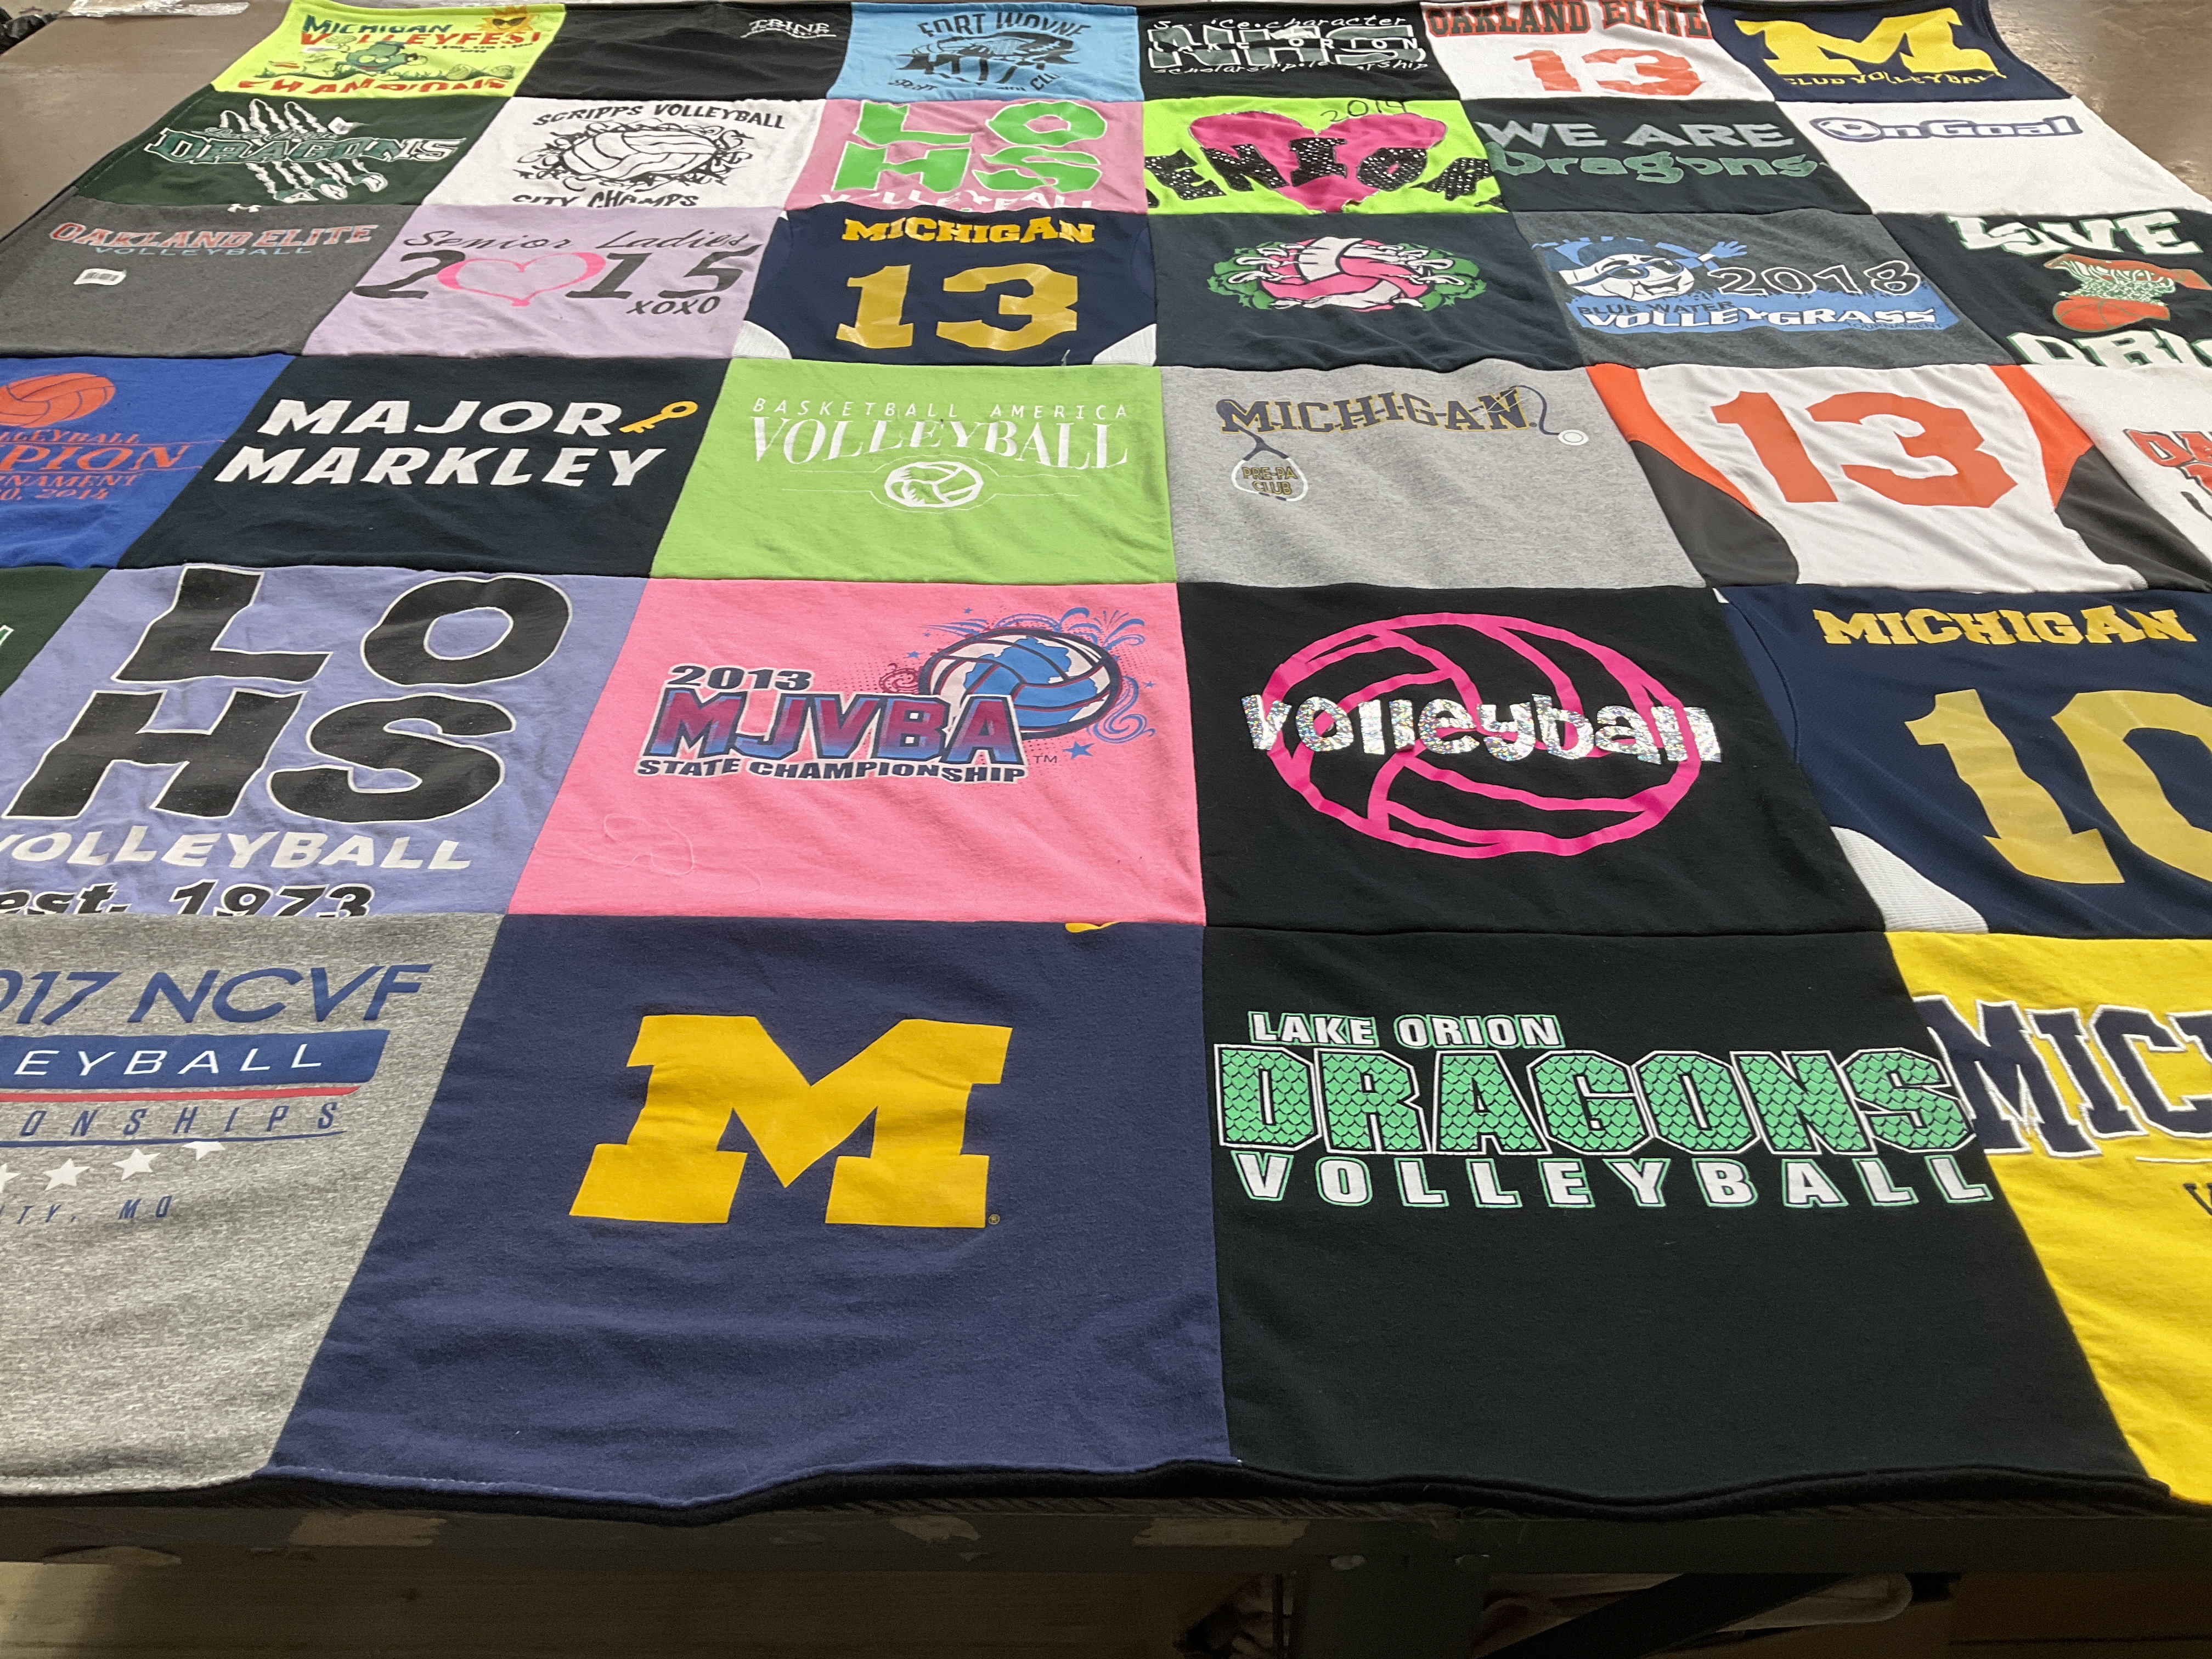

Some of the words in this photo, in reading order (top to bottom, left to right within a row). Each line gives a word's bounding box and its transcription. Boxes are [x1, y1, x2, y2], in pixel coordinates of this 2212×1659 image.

[303, 15, 453, 33] MICHIGAN
[748, 19, 831, 36] TRINE
[917, 13, 986, 37] FORT
[1426, 2, 1590, 37] OAKLAND
[1601, 0, 1714, 40] ELITE
[1288, 37, 1418, 49] ORION
[1735, 7, 2000, 75] M
[1514, 48, 1706, 96] 13
[533, 105, 644, 126] SCRIPPS
[654, 104, 786, 129] VOLLEYBALL
[1475, 120, 1607, 148] WE
[1623, 122, 1795, 148] ARE
[1810, 116, 2083, 142] OnGoal
[144, 127, 467, 163] DRAGONS
[1484, 141, 1819, 184] Dragons
[512, 194, 579, 207] CITY
[587, 189, 700, 207] CHAMPS
[49, 222, 254, 249] OAKLAND
[252, 224, 380, 247] ELITE
[402, 230, 574, 250] Senior
[596, 229, 751, 250] Ladies
[842, 217, 1095, 243] MICHIGAN
[1944, 211, 2204, 256] LOVE
[94, 246, 312, 256] VOLLEYBALL
[1706, 259, 1922, 297] 2018
[836, 263, 1079, 351] 13
[1577, 301, 1639, 315] BLUE
[1644, 300, 1736, 314] WATER
[257, 399, 622, 436] MAJOR
[752, 397, 958, 418] BASKETBALL
[990, 403, 1129, 420] AMERICA
[1217, 387, 1531, 433] MICHIGAN
[750, 415, 1129, 470] VOLLEYBALL
[1711, 391, 2018, 508] 13
[0, 475, 144, 487] NAMENT
[214, 445, 667, 487] MARKLEY
[1242, 466, 1299, 480] PRE-PA
[1252, 481, 1293, 495] CLUB
[110, 564, 573, 687] LO
[1812, 605, 2198, 645] MICHIGAN
[668, 663, 812, 691] 2013
[640, 687, 1027, 767] MJVBA
[1241, 693, 1722, 765] volleyball
[1, 689, 517, 823] HS
[636, 757, 742, 778] STATE
[747, 759, 1027, 783] CHAMPIONSHIP
[1904, 688, 2212, 885] 10
[0, 825, 472, 870] VOLLEYBALL
[168, 878, 376, 918] 1973
[127, 963, 433, 1024] NCVF
[1248, 1012, 1379, 1048] LAKE
[1395, 1013, 1567, 1048] ORION
[14, 1043, 323, 1076] EYBALL
[1214, 1043, 1977, 1156] DRAGONS
[19, 1102, 337, 1137] ONSHIPS
[568, 1014, 1013, 1229] M
[1234, 1153, 1994, 1208] VOLLEYBALL
[118, 1195, 173, 1220] MO
